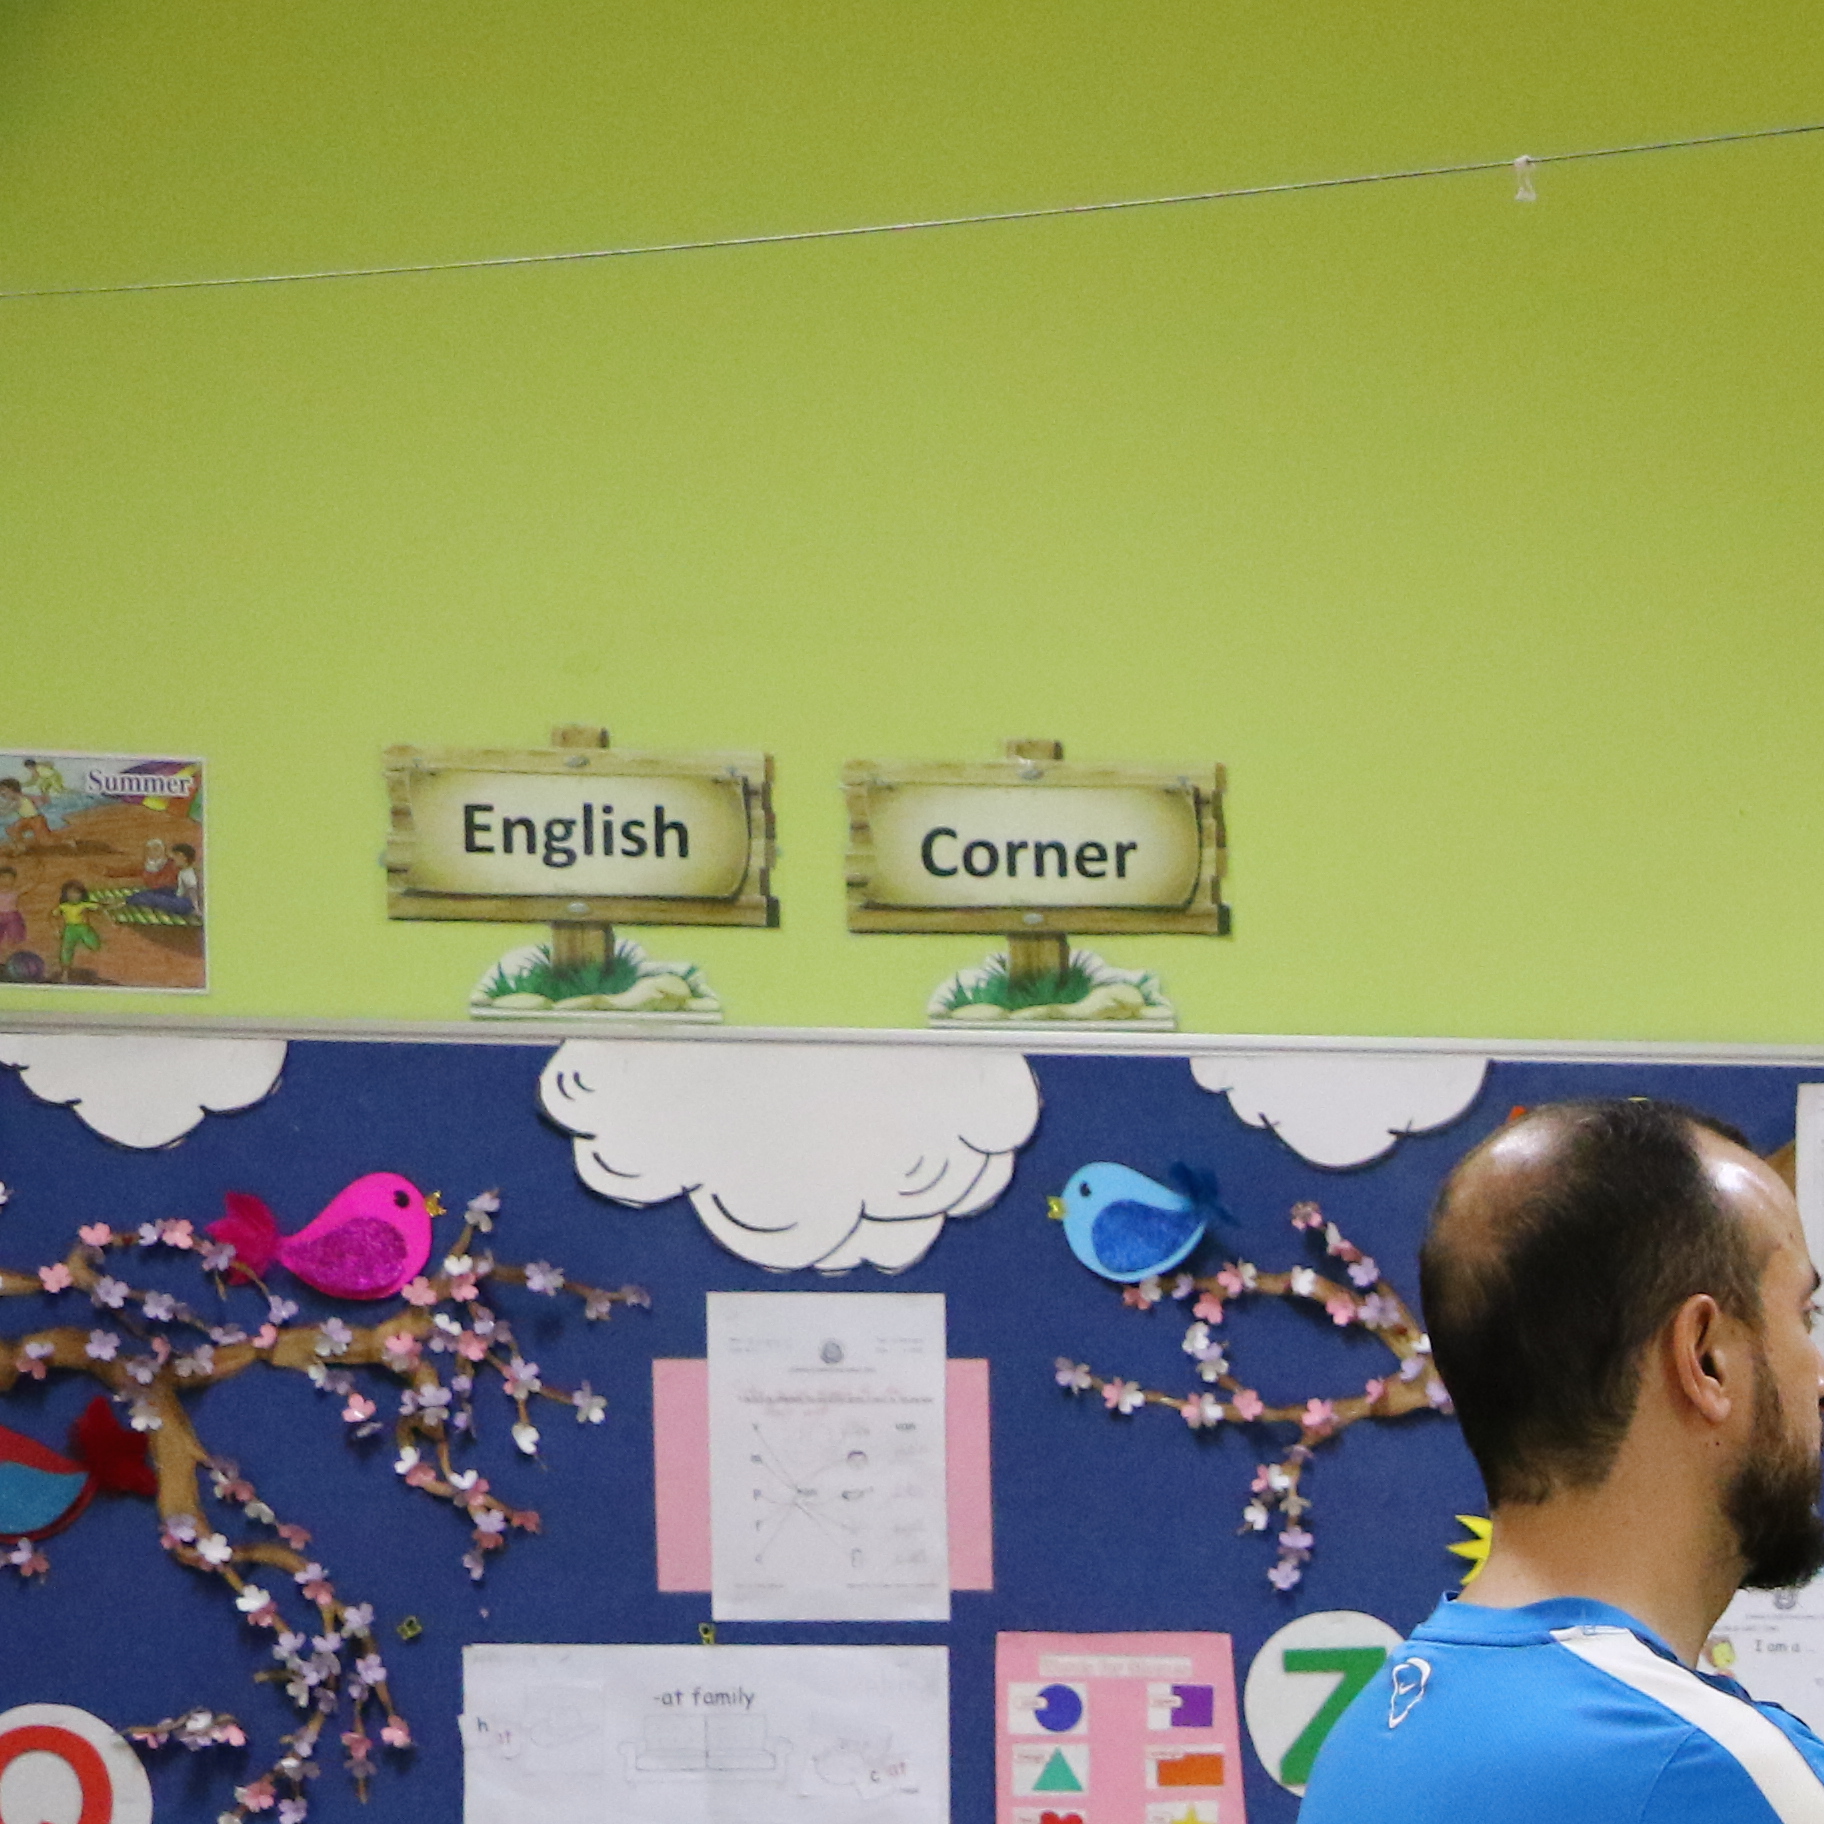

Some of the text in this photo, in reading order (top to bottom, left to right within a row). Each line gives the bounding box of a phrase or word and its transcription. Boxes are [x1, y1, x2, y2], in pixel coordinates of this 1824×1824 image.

[88, 769, 191, 793] Summer
[462, 802, 691, 867] English
[919, 825, 1138, 882] Corner
[692, 1686, 755, 1710] family
